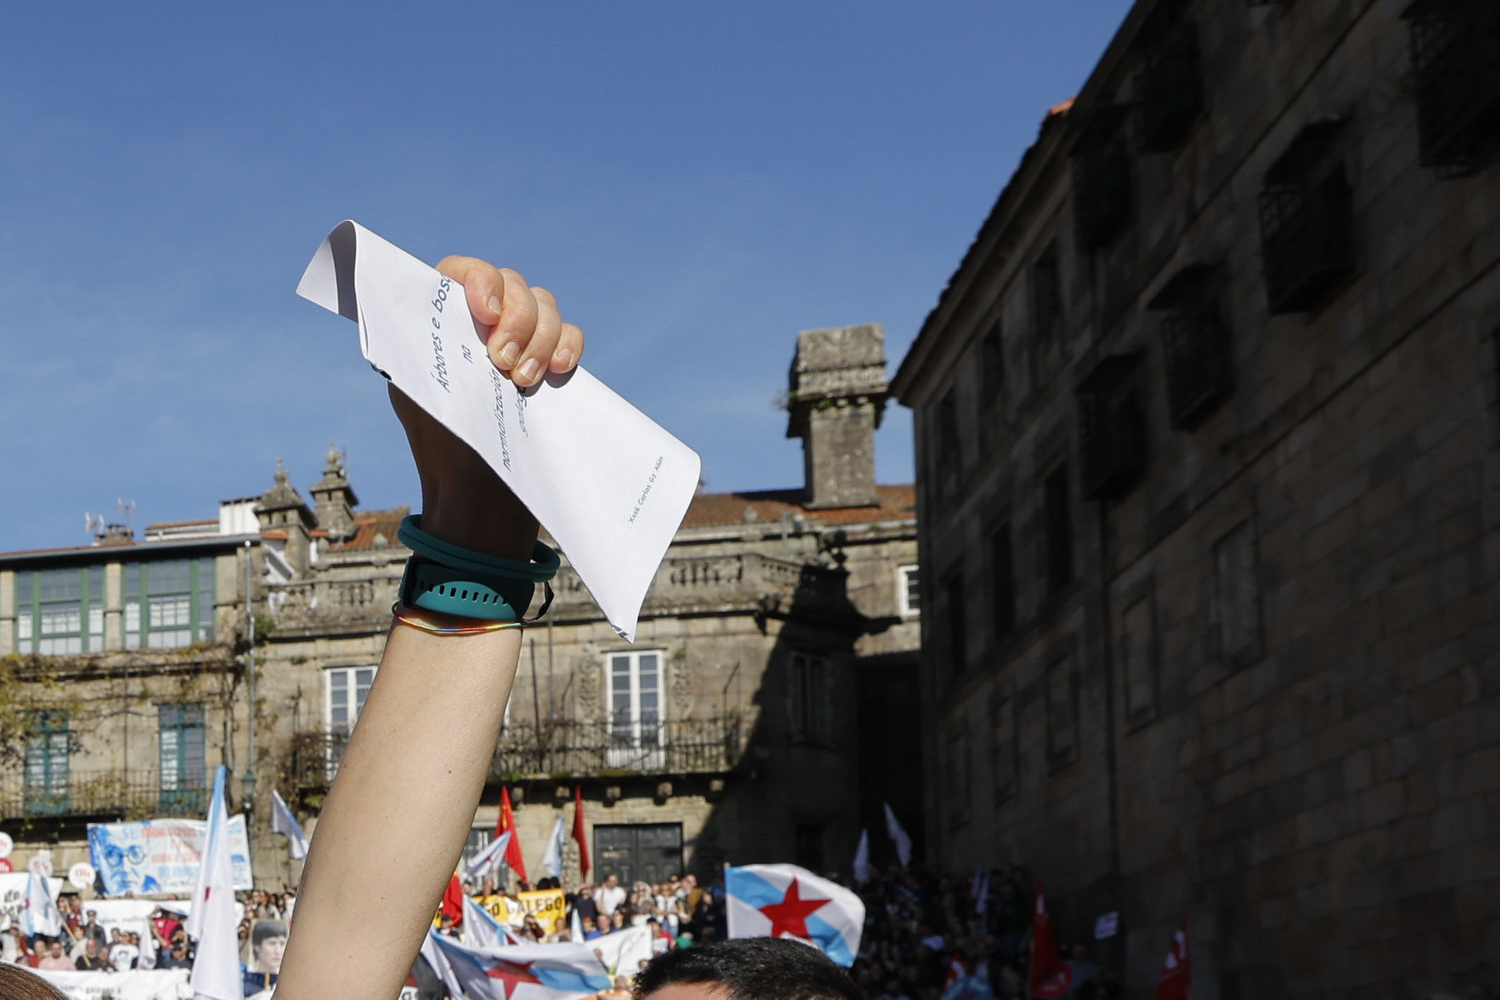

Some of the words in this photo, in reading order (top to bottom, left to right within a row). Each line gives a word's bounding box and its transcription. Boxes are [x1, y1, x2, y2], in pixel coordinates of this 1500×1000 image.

[431, 319, 441, 330] e
[430, 333, 451, 393] Árbores
[462, 345, 473, 364] na
[488, 369, 512, 472] normalización
[637, 484, 652, 506] Carlos
